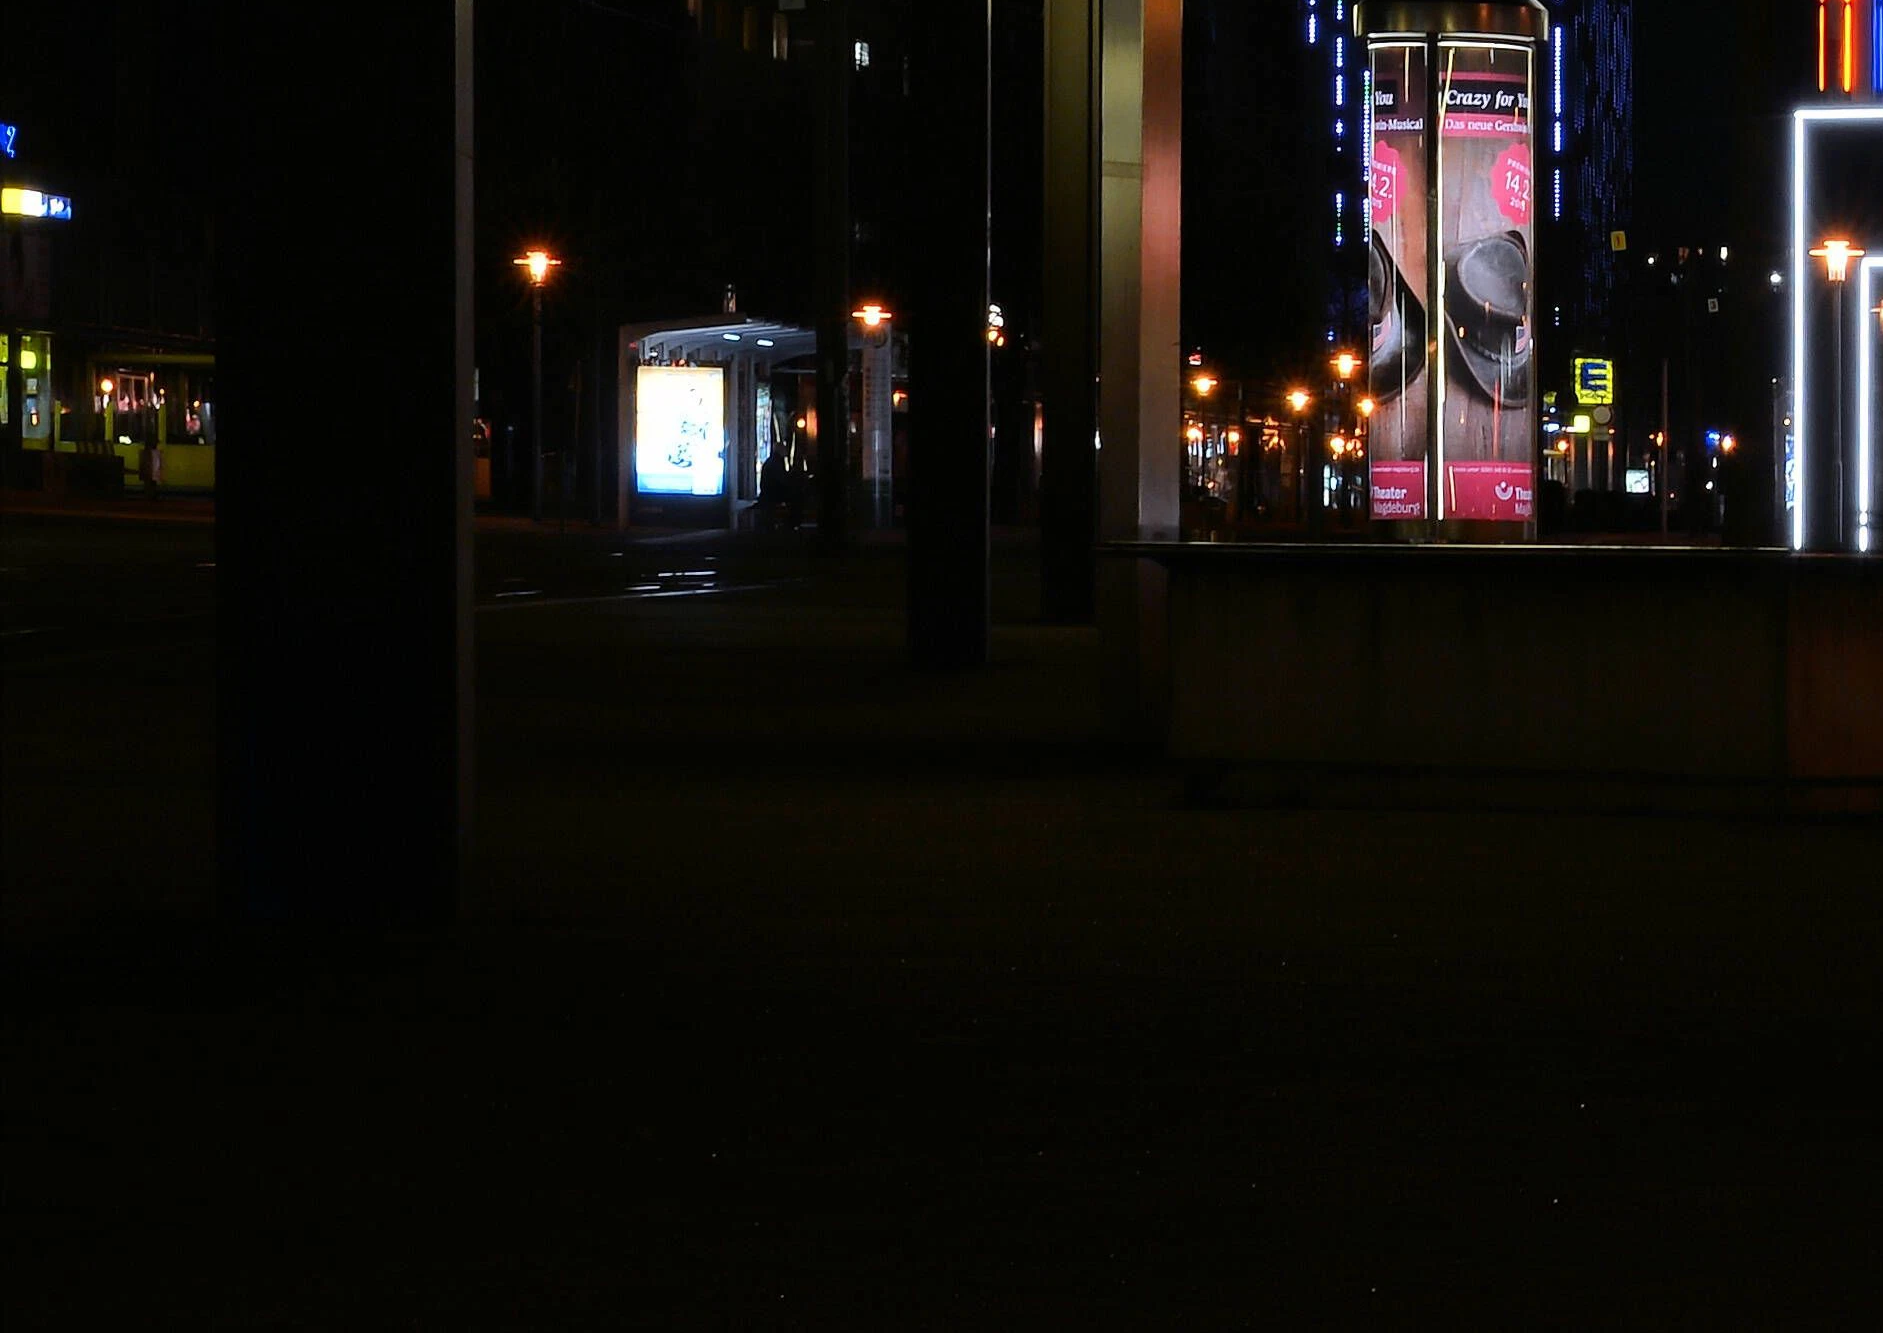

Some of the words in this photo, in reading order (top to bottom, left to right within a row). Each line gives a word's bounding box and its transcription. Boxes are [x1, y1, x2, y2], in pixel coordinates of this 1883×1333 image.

[1445, 89, 1491, 109] Crazy
[1494, 90, 1515, 109] for
[1445, 118, 1465, 130] Das
[1467, 121, 1493, 131] neue
